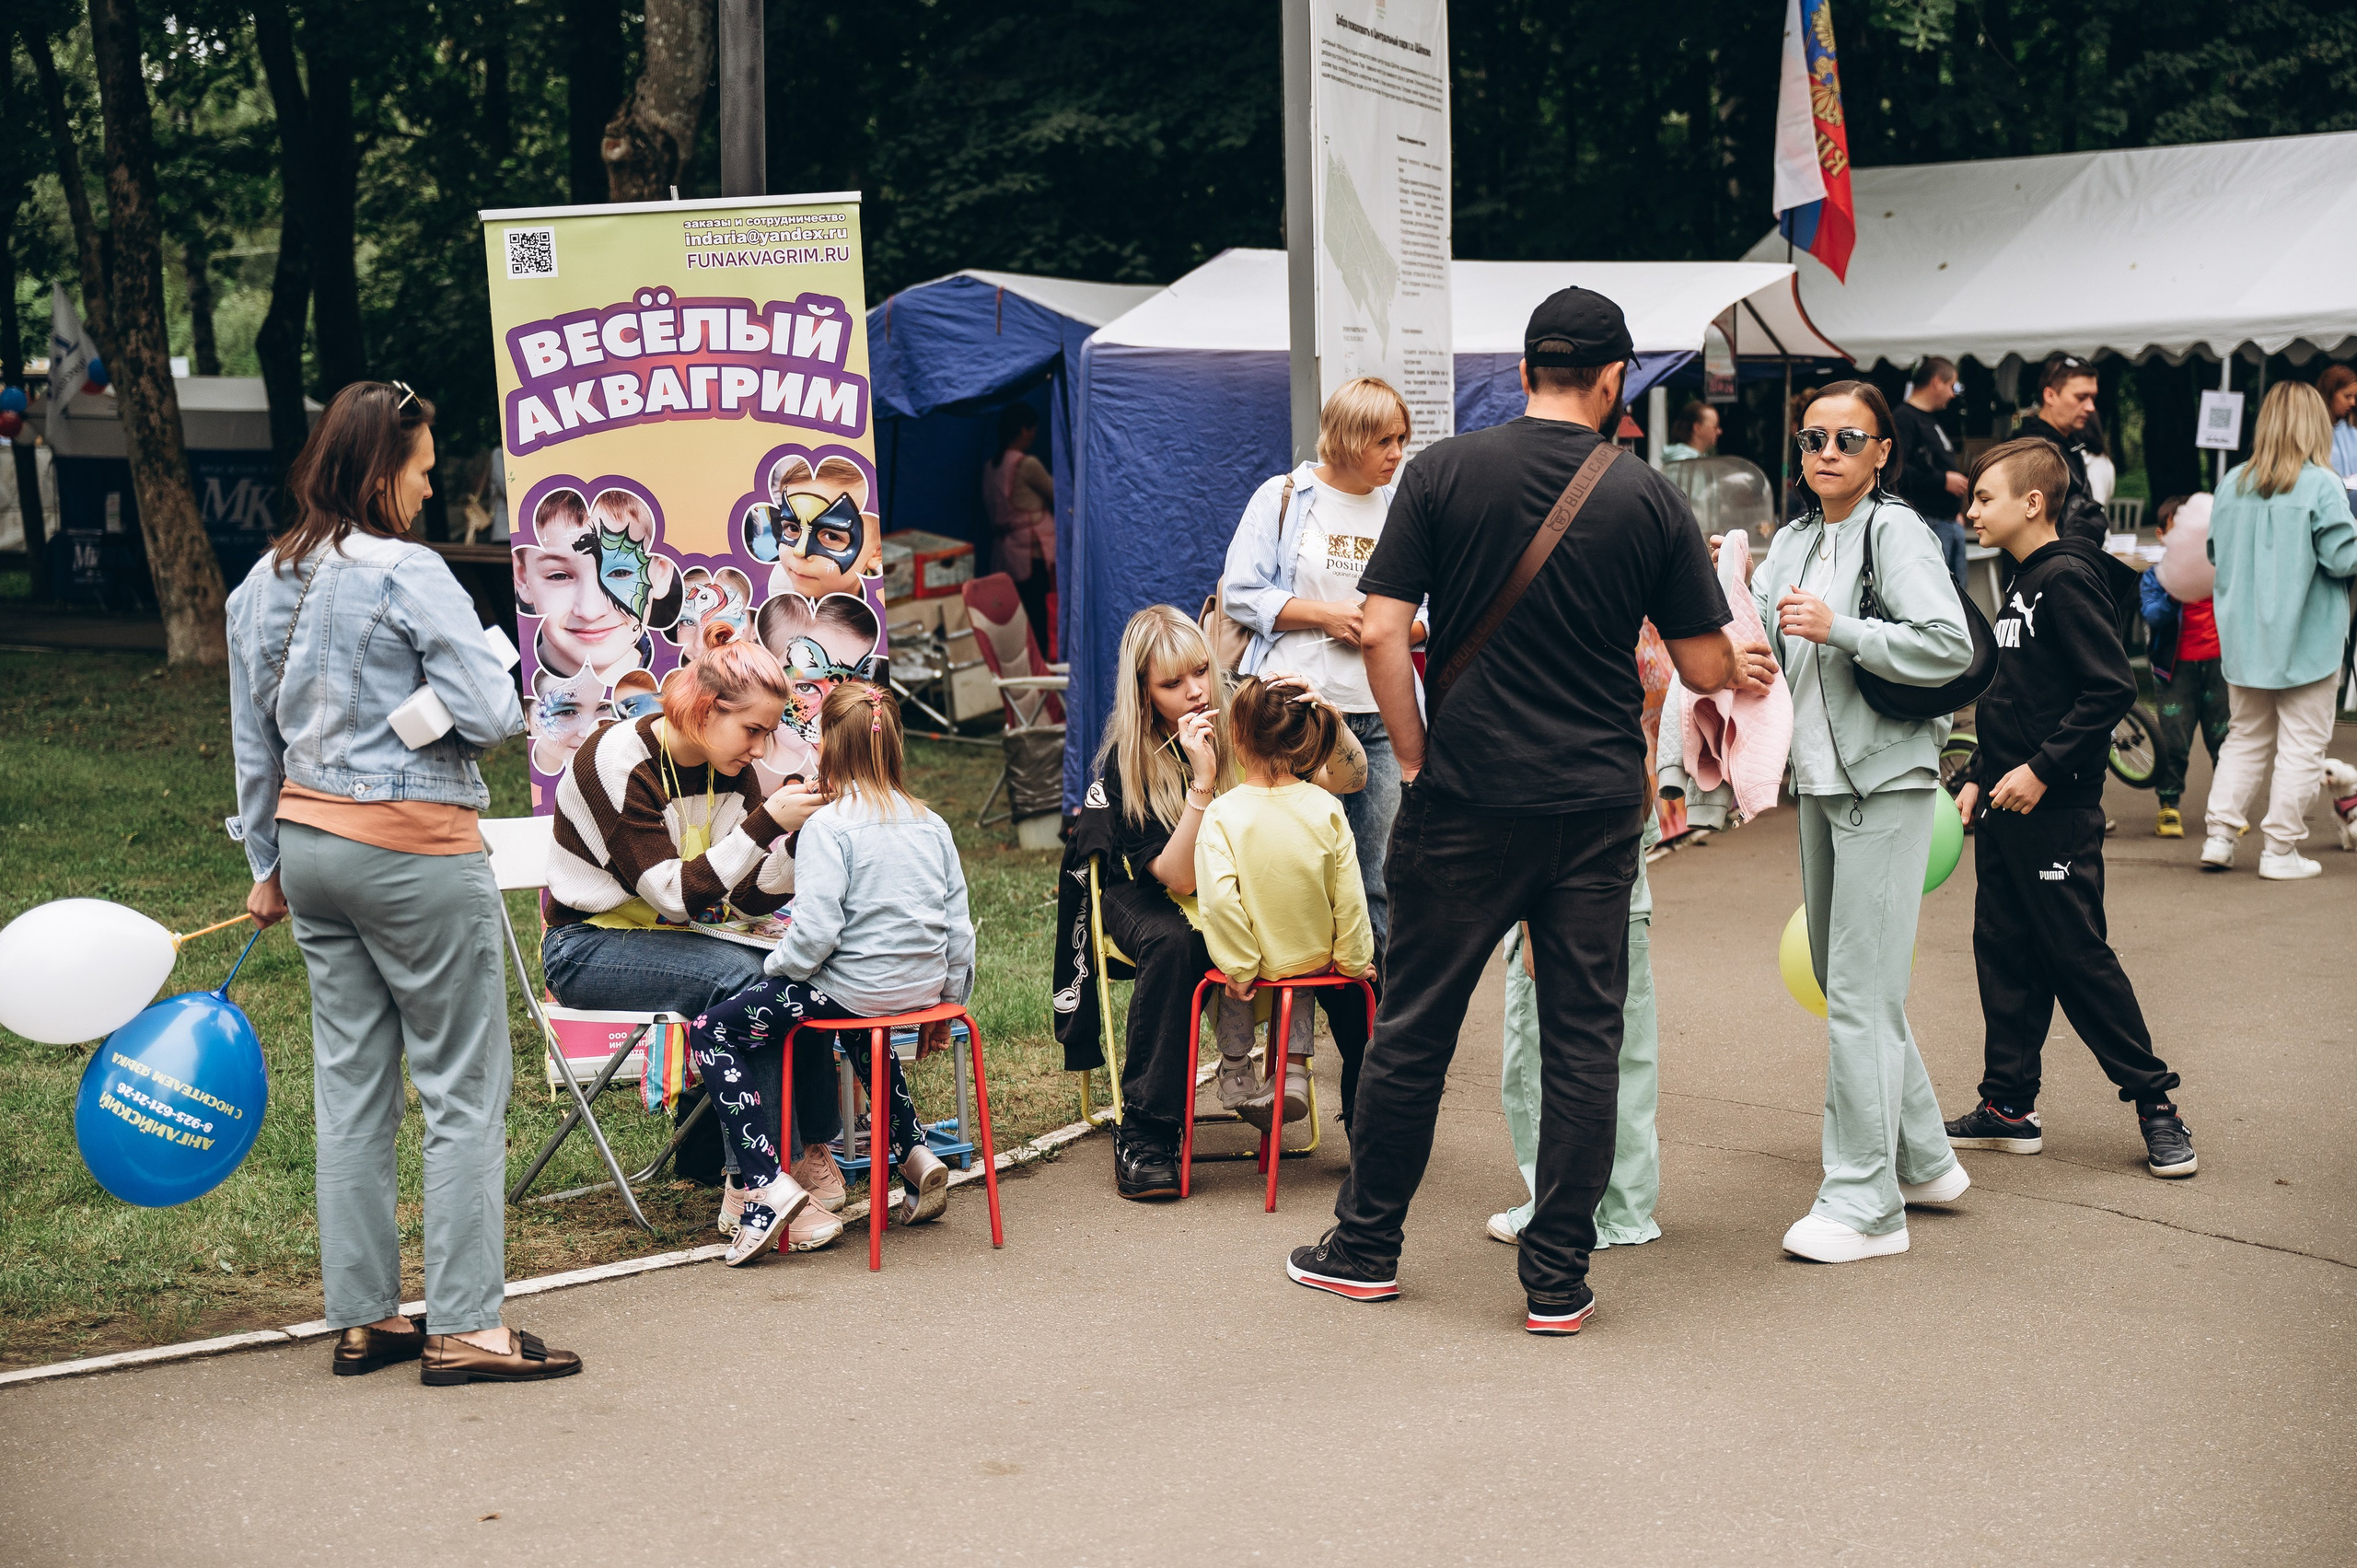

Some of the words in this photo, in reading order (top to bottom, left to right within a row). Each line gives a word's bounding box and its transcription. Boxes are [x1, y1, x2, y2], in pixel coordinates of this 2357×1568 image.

[684, 219, 731, 228] заказы
[735, 218, 744, 227] и
[745, 213, 846, 227] сотрудничество
[685, 228, 848, 246] indaria@yandex.ru
[687, 246, 850, 269] FUNAKVAGRIM.RU
[518, 293, 842, 378] ВЕСЁЛЫЙ
[518, 366, 859, 446] АКВАГРИМ
[1326, 558, 1364, 572] positi
[1993, 619, 2022, 648] MA
[2038, 870, 2065, 880] PUMA
[111, 1051, 152, 1075] ЯЗЫКА
[117, 1082, 214, 1132] 8-925-621-21-26
[152, 1071, 235, 1117] НОСИТЕЛЕМ
[99, 1091, 215, 1151] АНГЛИЙСКИЙ
